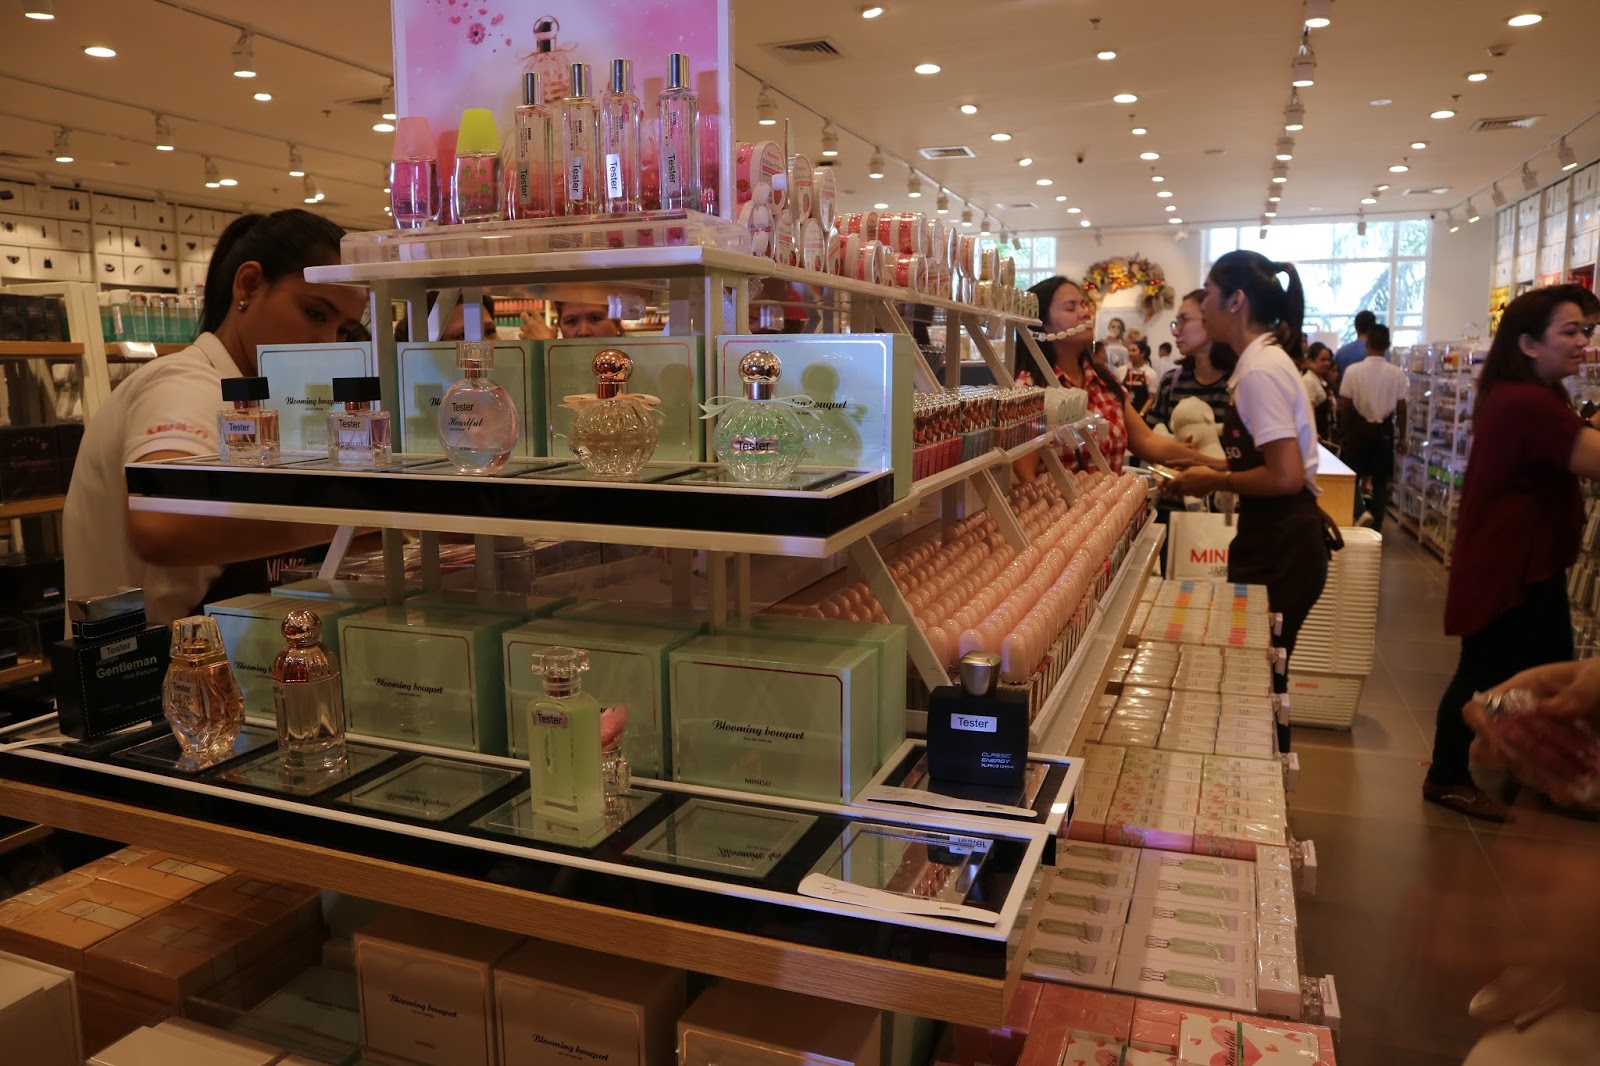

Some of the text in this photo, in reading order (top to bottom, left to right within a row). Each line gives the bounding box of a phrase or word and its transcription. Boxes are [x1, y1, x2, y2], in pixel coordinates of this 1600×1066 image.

[667, 154, 676, 184] Tester
[572, 164, 582, 193] Tester
[609, 162, 619, 190] Tester
[519, 168, 528, 198] Tester
[285, 396, 316, 406] Blooming
[452, 402, 474, 412] Tester
[809, 400, 848, 410] ouquet
[228, 422, 250, 433] Tester
[338, 419, 361, 429] Tester
[448, 416, 483, 431] Heartful
[736, 440, 771, 452] Tester
[1190, 549, 1230, 563] MIN
[1208, 566, 1228, 576] JAP
[105, 642, 132, 655] Tester
[96, 656, 158, 679] Gentleman
[235, 660, 267, 674] Blooming
[173, 682, 191, 693] Tester
[374, 677, 443, 694] Blooming bouquet
[537, 712, 563, 725] Tester
[958, 717, 989, 729] Tester
[712, 719, 806, 740] Blooming bouquet
[981, 751, 1012, 759] CLASSIC
[744, 777, 772, 787] MINISO
[388, 993, 426, 1011] Blooming
[427, 1003, 457, 1018] bouquet
[532, 1033, 574, 1052] Blooming
[575, 1045, 609, 1061] bouquet
